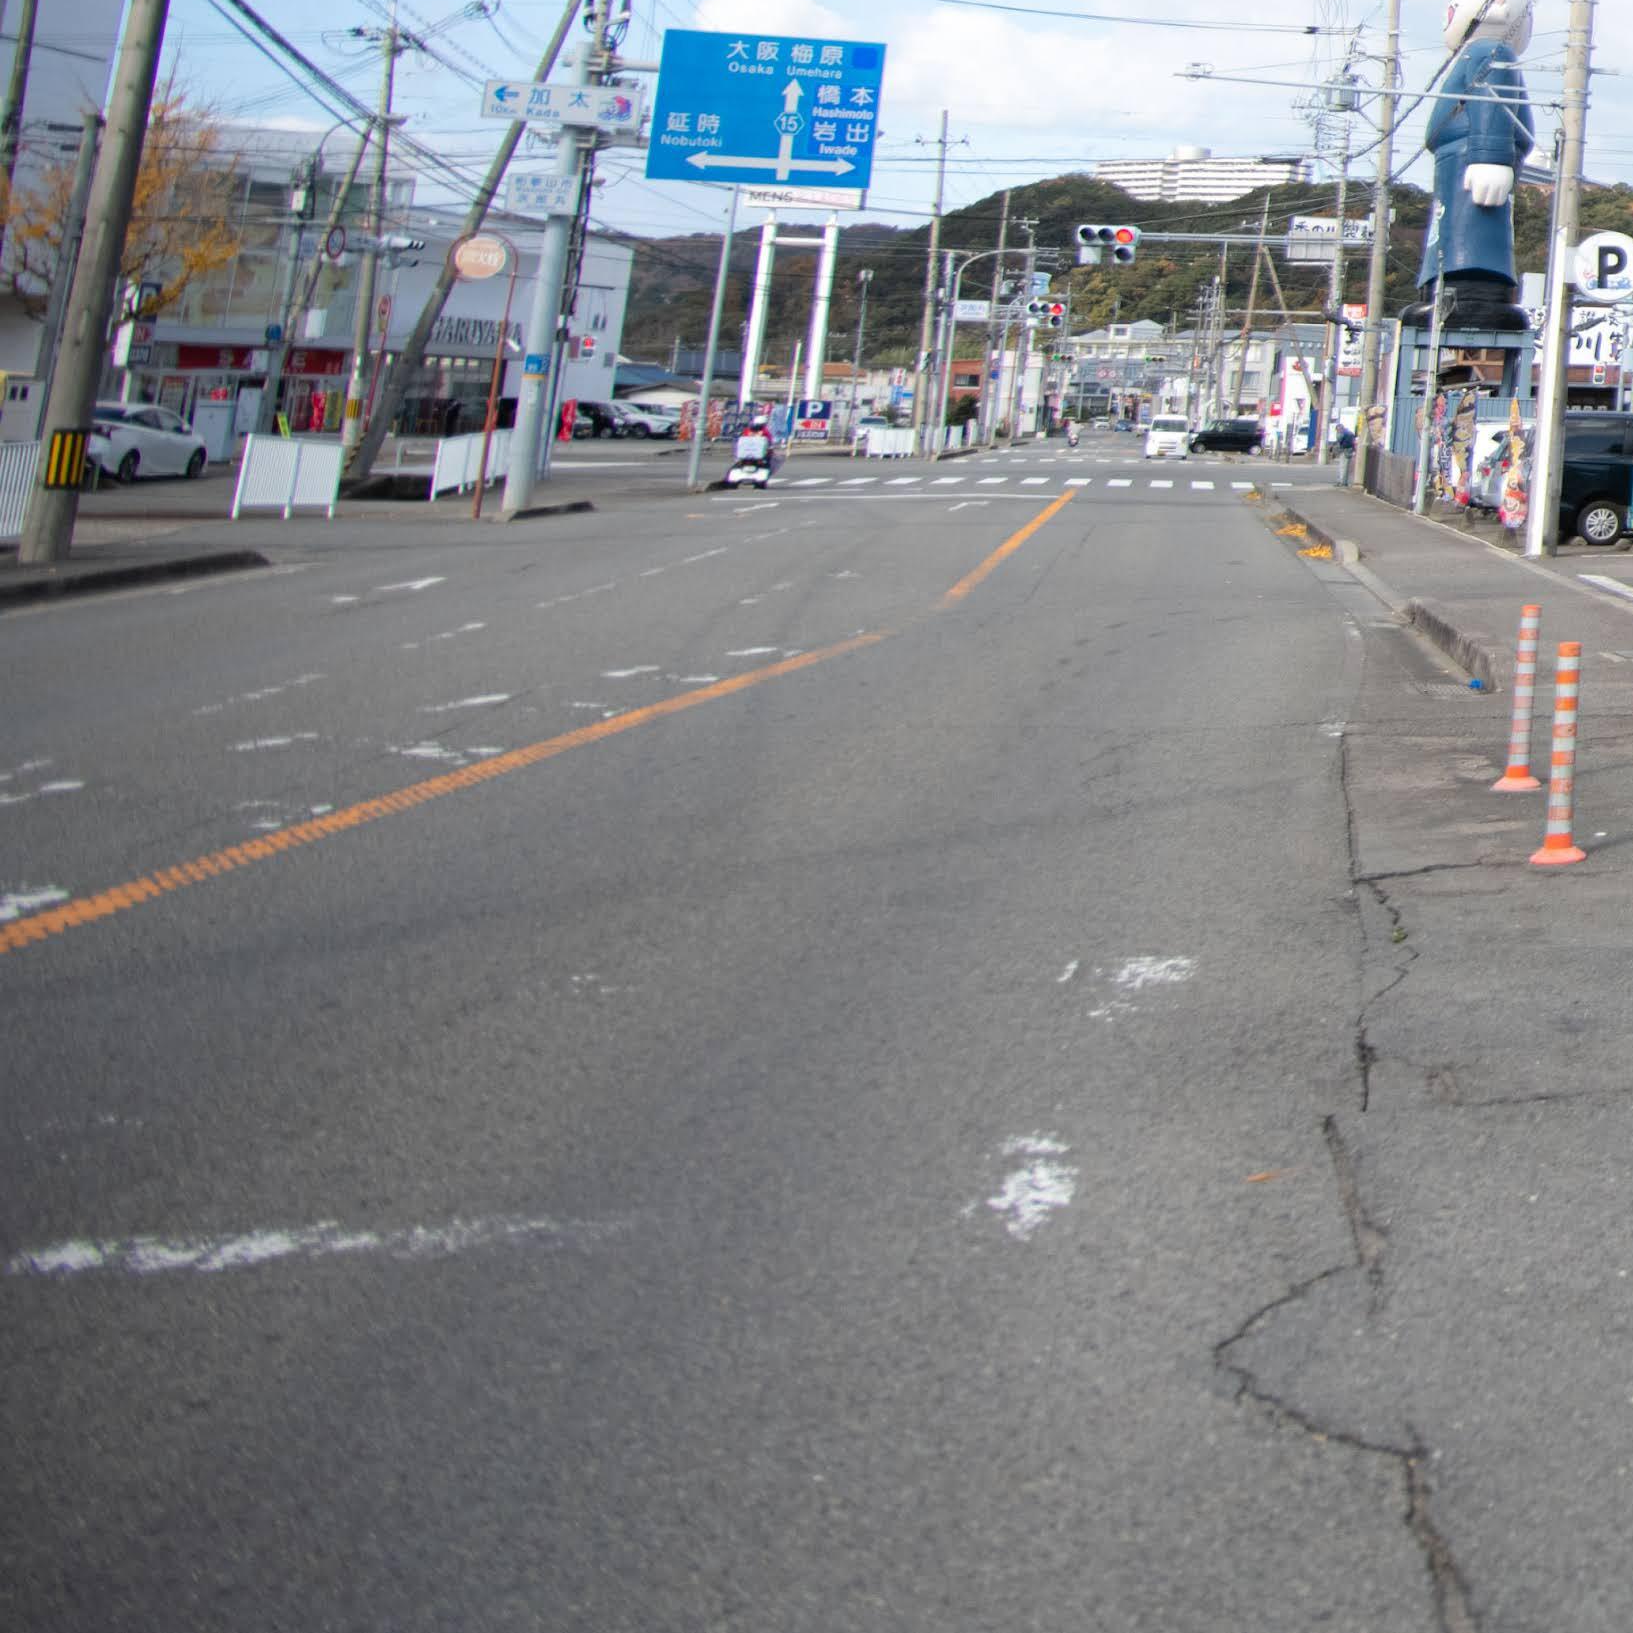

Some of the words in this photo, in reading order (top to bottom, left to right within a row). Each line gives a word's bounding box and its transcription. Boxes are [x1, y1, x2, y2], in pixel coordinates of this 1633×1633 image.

[726, 40, 780, 62] 大阪
[728, 61, 774, 76] Osaka
[786, 66, 842, 80] Umehara
[528, 87, 592, 109] 加太
[817, 84, 875, 106] 橋本
[526, 107, 561, 118] Kada
[812, 106, 874, 121] Hashimoto
[666, 111, 721, 135] 延時
[780, 116, 798, 133] 15
[660, 134, 723, 148] Nobutoki
[812, 122, 870, 143] 岩出
[819, 143, 858, 156] Iwade
[749, 190, 793, 203] MENS
[1597, 245, 1629, 289] P
[807, 401, 824, 418] P
